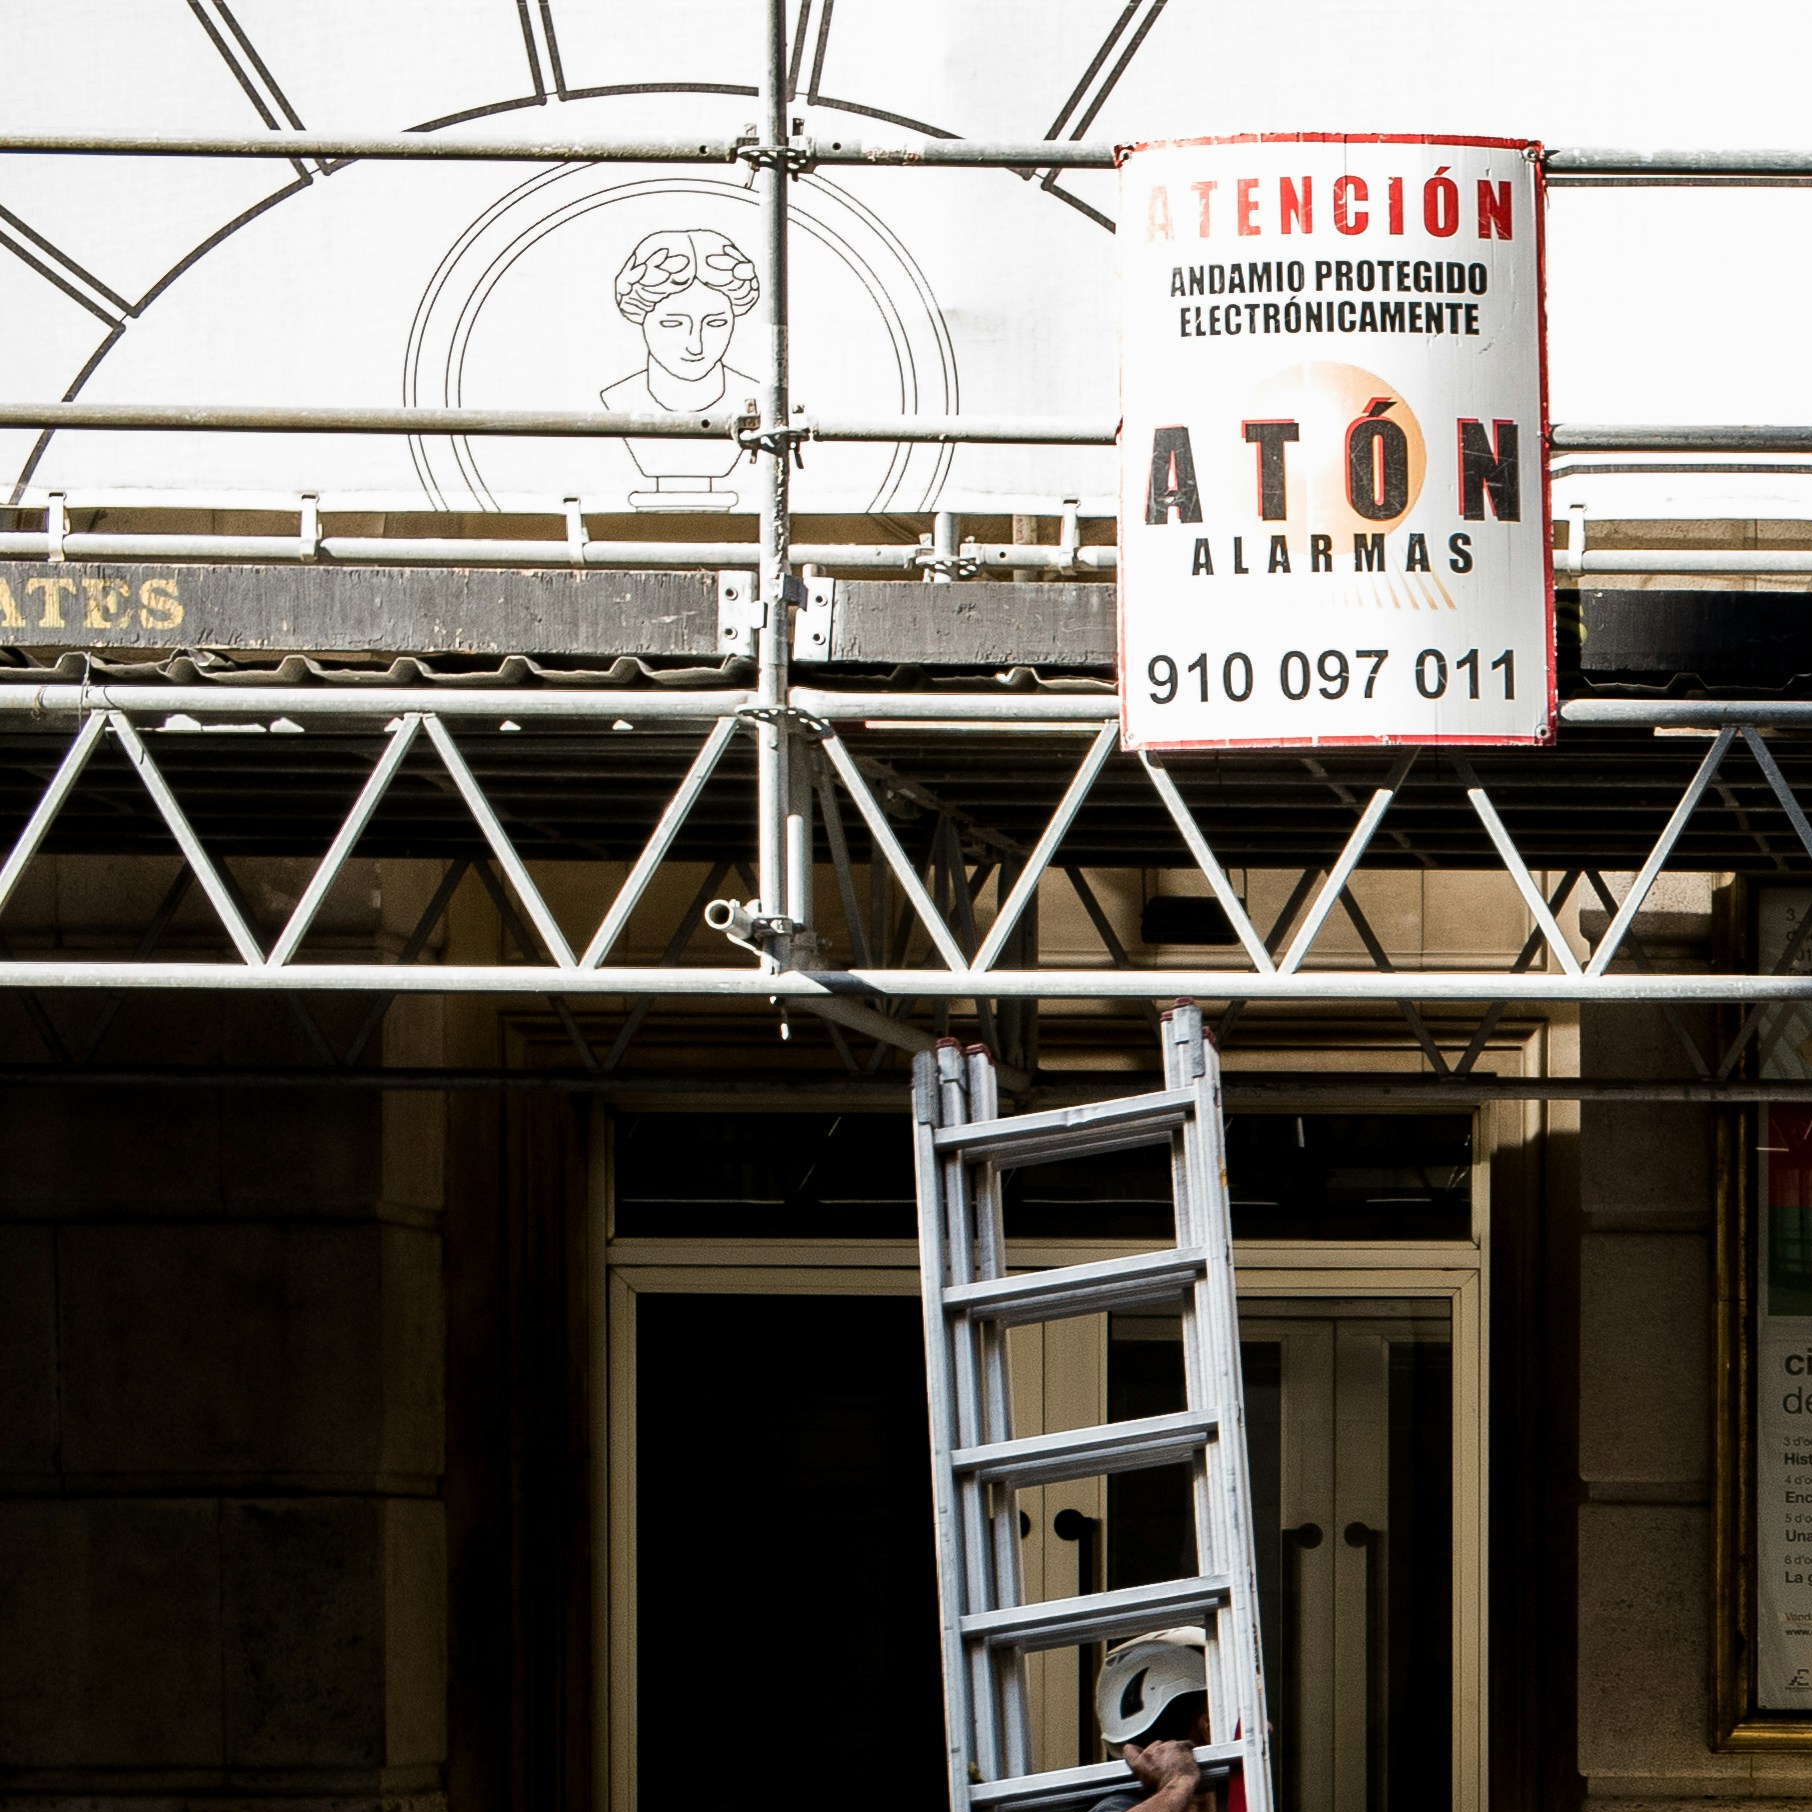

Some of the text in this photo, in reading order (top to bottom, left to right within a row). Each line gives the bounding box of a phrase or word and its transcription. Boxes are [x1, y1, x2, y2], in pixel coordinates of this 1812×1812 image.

[1146, 166, 1513, 241] ATENCIÓN
[1170, 259, 1488, 297] ANDAMIO PROTEGIDO
[1180, 297, 1480, 337] ELECTRÓNICAMENTE
[1145, 398, 1521, 524] ATÓN
[1192, 533, 1473, 575] ALARMAS
[1147, 648, 1516, 705] 910 097 011
[1785, 1572, 1803, 1584] La
